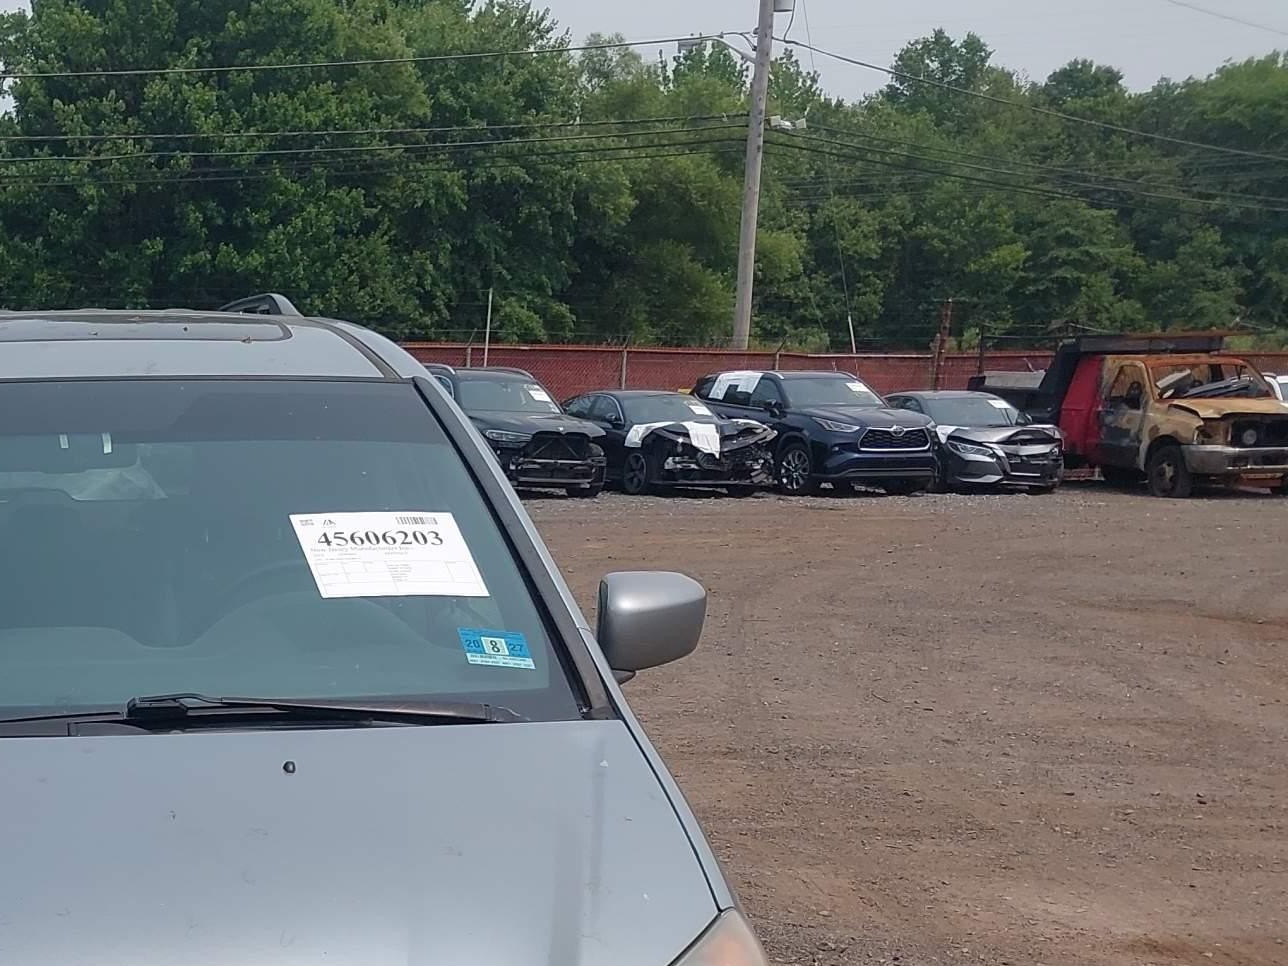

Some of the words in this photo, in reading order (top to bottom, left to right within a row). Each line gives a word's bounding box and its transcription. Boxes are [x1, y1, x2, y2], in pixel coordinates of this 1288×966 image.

[317, 530, 444, 547] 45606203
[464, 639, 480, 649] 20
[489, 639, 501, 653] 8
[508, 643, 524, 652] 27
